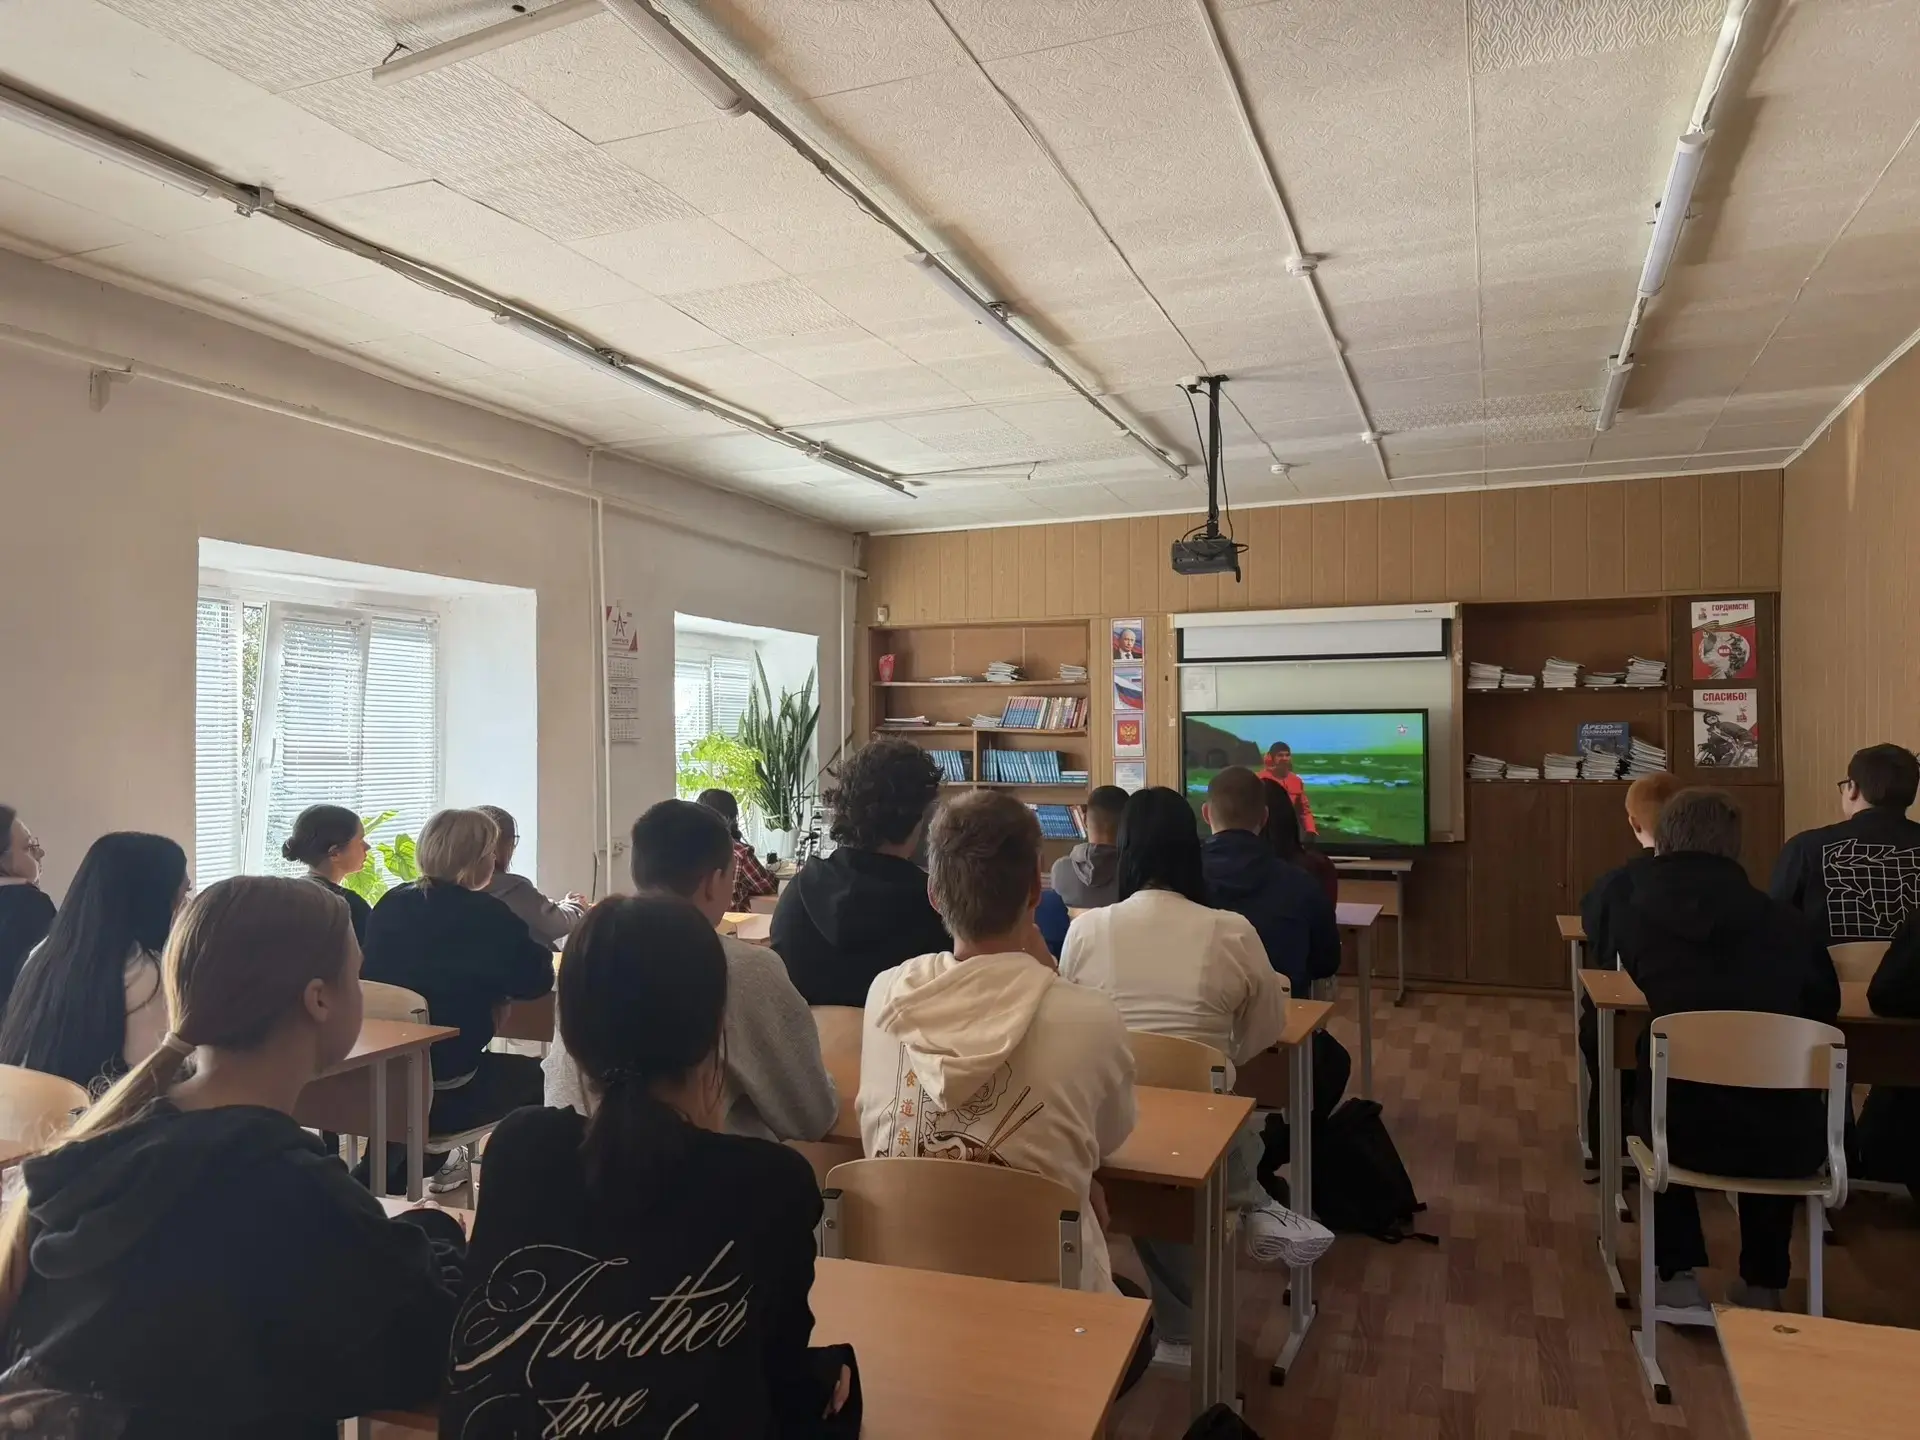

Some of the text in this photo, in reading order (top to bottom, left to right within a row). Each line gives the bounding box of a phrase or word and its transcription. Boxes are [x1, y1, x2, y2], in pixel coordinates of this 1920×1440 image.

[1711, 603, 1749, 612] ГОРДИМСЯ!
[1702, 692, 1748, 702] СПАСИБО!
[449, 1240, 753, 1390] Another
